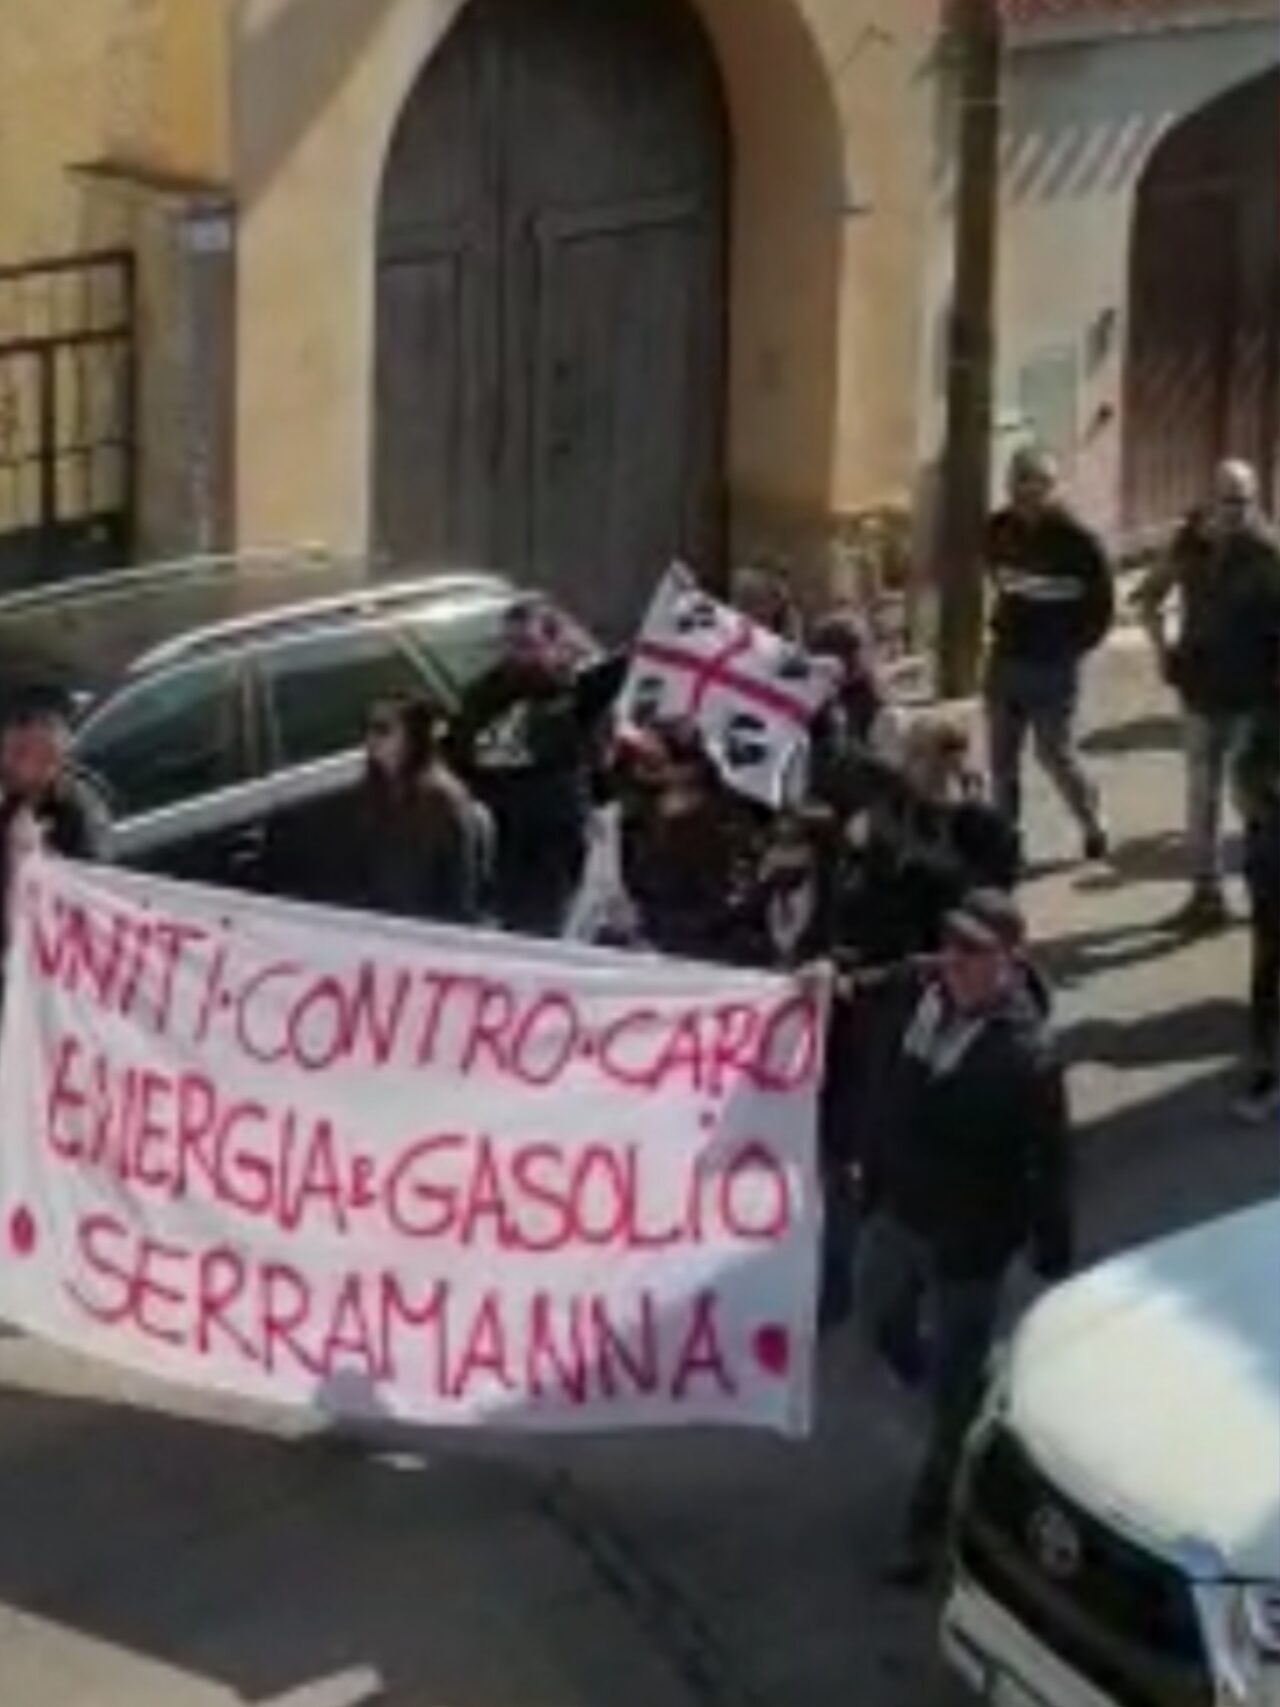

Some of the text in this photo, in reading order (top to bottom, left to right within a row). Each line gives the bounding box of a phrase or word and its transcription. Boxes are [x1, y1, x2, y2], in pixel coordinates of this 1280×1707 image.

[237, 960, 577, 1085] CONTRO
[600, 998, 818, 1096] CARO
[48, 1037, 349, 1236] ENERGIA
[64, 1214, 736, 1404] SERRAMANNA
